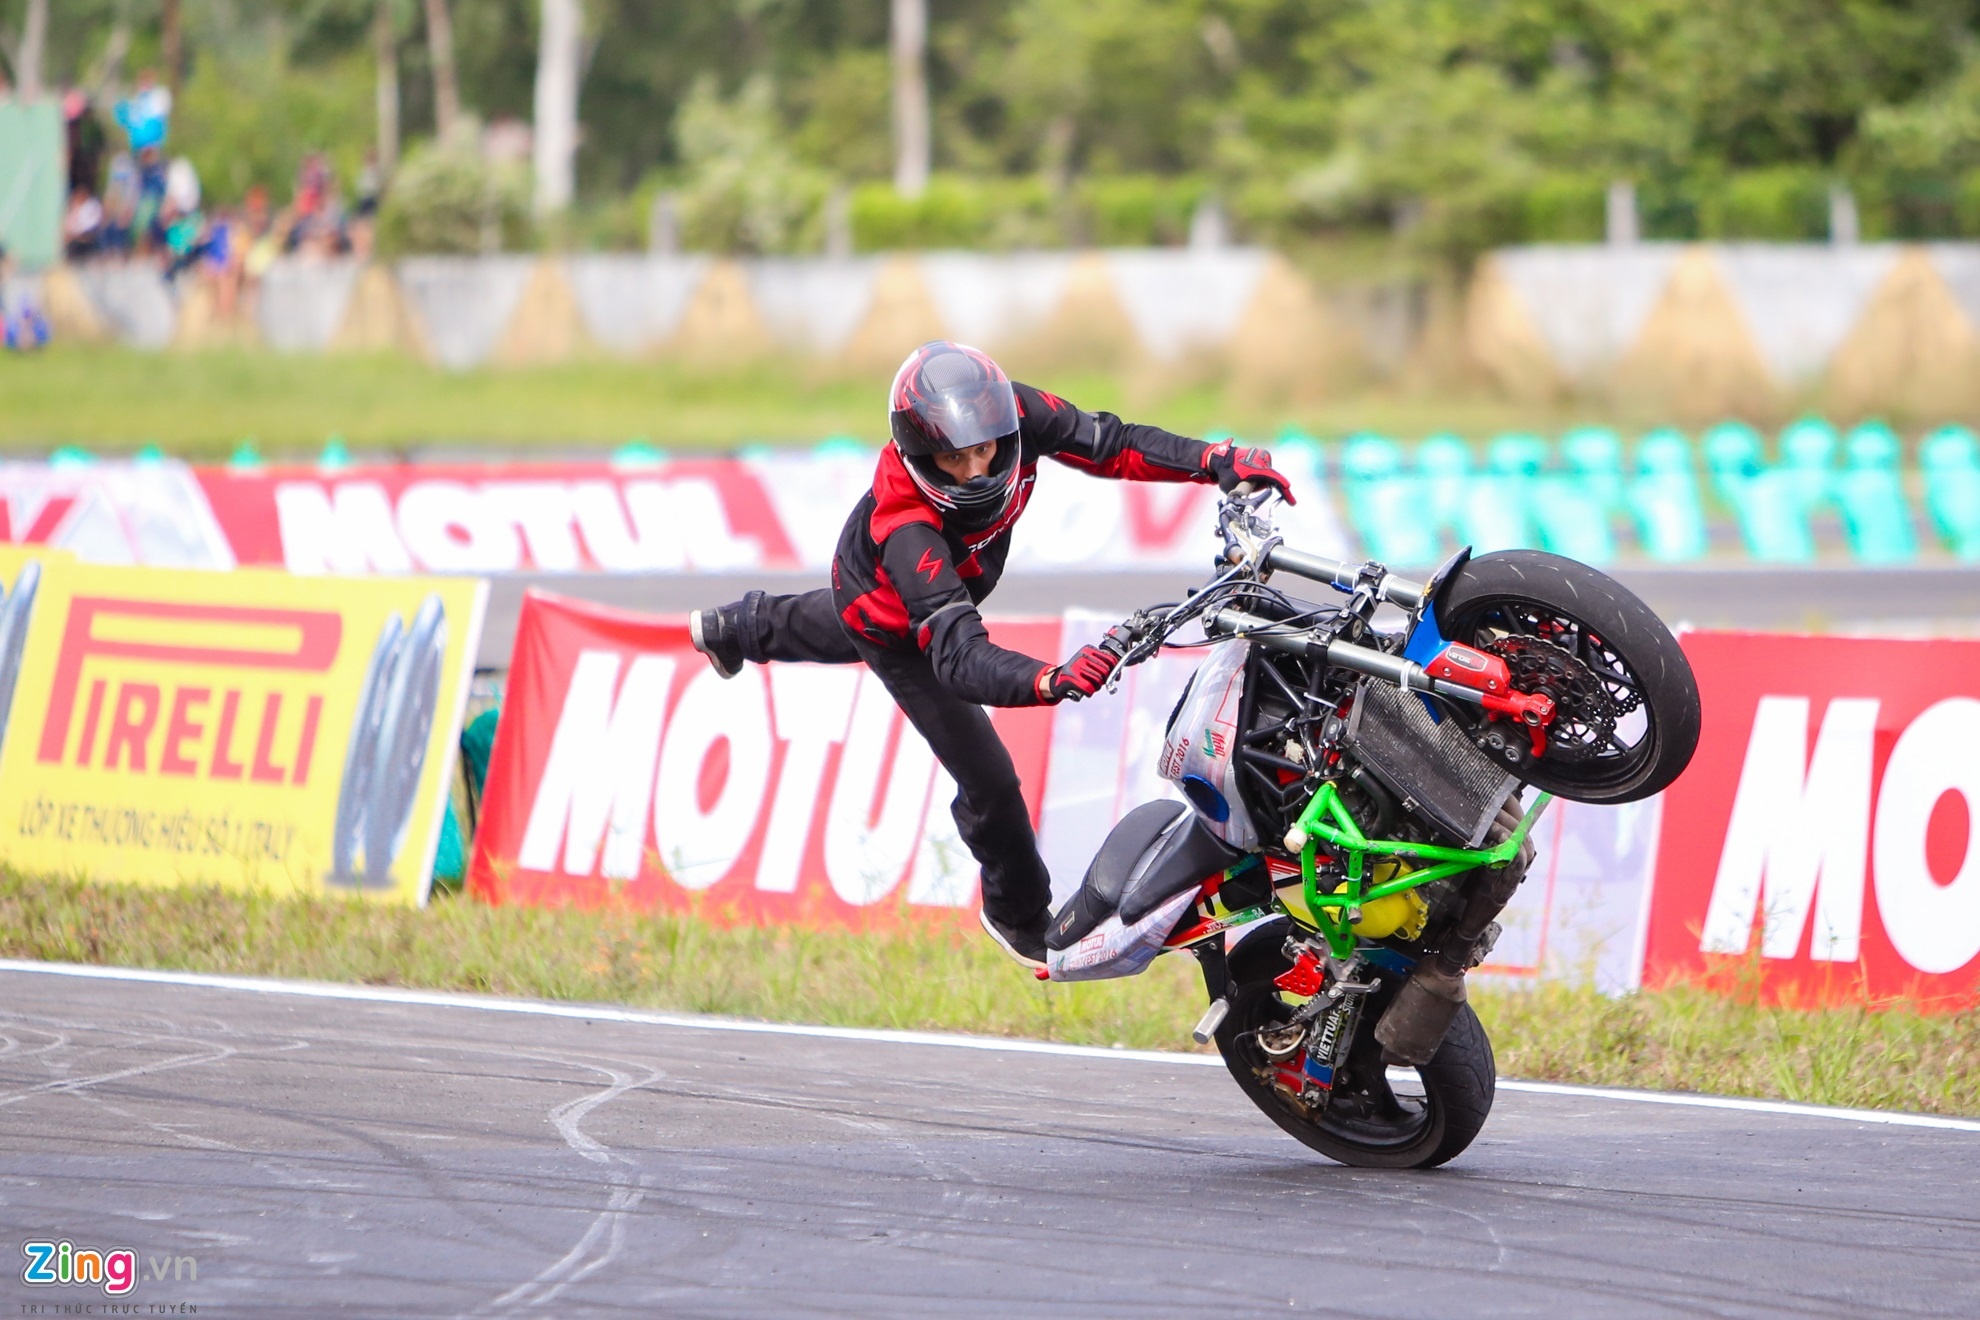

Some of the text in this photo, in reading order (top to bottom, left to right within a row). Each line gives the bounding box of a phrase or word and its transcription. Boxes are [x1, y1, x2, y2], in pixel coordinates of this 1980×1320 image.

[275, 479, 760, 573] MOTUL
[36, 595, 343, 788] PIRELLI
[1176, 737, 1190, 762] 2016
[1700, 696, 1980, 974] MO
[1081, 935, 1104, 953] MOTUL
